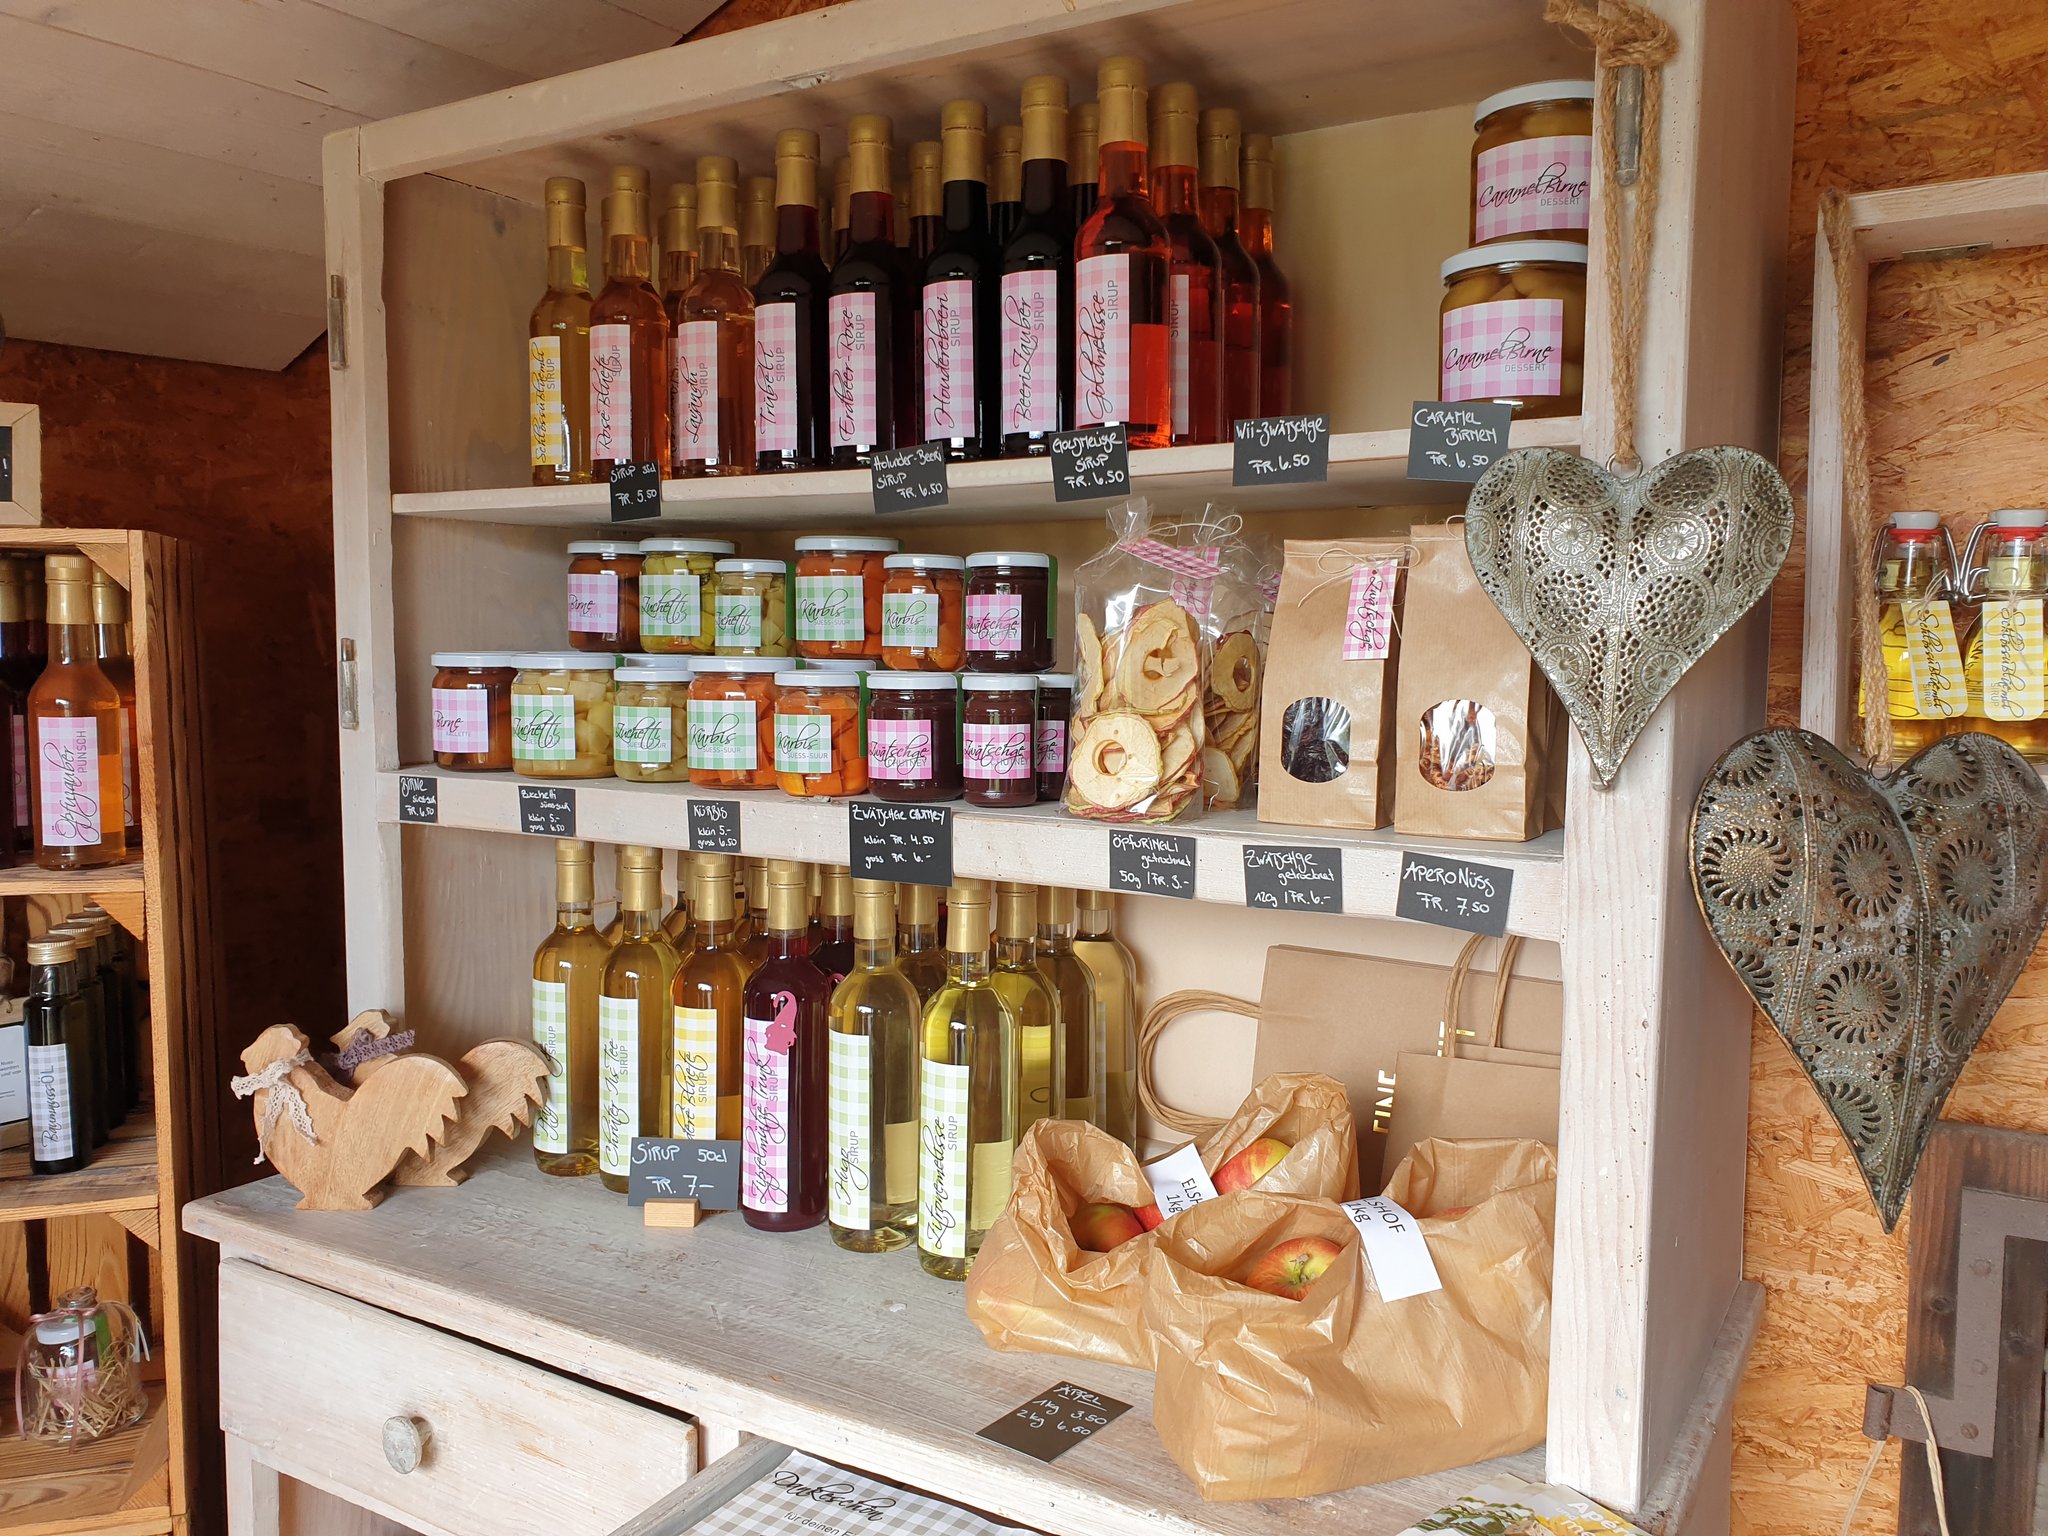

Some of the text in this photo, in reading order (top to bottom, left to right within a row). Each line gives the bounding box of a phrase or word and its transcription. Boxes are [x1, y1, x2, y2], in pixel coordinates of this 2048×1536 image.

[1541, 197, 1580, 206] DESSERT
[1034, 292, 1044, 331] SIRUP
[1107, 280, 1118, 320] SIRUP
[855, 314, 865, 350] SIRUP
[950, 309, 960, 347] SIRUP
[612, 345, 621, 377] SIRUP
[776, 347, 785, 382] SIRUP
[925, 293, 955, 428] Houderebeeri
[1079, 290, 1113, 419] Goldmelisse
[1504, 363, 1546, 373] DESSERT
[546, 358, 555, 390] SIRUP
[699, 362, 709, 395] SIRUP
[756, 341, 778, 434] Trübeli
[592, 354, 622, 456] Rose Blüete
[680, 356, 702, 444] Lavändu
[1279, 454, 1310, 470] 6.50
[1455, 452, 1488, 468] 6.50
[919, 483, 943, 496] 6.50
[1093, 470, 1124, 485] 6.50
[637, 489, 657, 503] 5.50
[1922, 684, 1933, 708] SIRUP
[77, 730, 87, 773] PUNSCH
[719, 837, 737, 847] 6.50
[910, 834, 934, 845] 4.50
[1119, 870, 1141, 889] 50g
[1456, 897, 1490, 916] 7.50
[548, 1026, 557, 1054] SIRUP
[603, 1038, 619, 1068] Tee
[620, 1045, 629, 1075] SIRUP
[675, 1050, 708, 1107] Blüete
[698, 1072, 708, 1103] SIRUP
[770, 1070, 779, 1102] SIRUP
[601, 1099, 629, 1167] Chrüter
[746, 1036, 789, 1206] Zipfelmütze Trunk
[947, 1115, 958, 1151] SIRUP
[697, 1148, 727, 1163] 50cl
[849, 1130, 859, 1164] SIRUP
[834, 1147, 869, 1205] Hugo
[922, 1116, 956, 1249] Zitronemelisse
[1166, 1194, 1184, 1213] 1kg
[1346, 1203, 1371, 1223] 1kg
[1070, 1410, 1108, 1425] 3.50
[772, 1470, 896, 1521] Dankeschön
[784, 1512, 800, 1522] für
[801, 1519, 840, 1536] deinen
